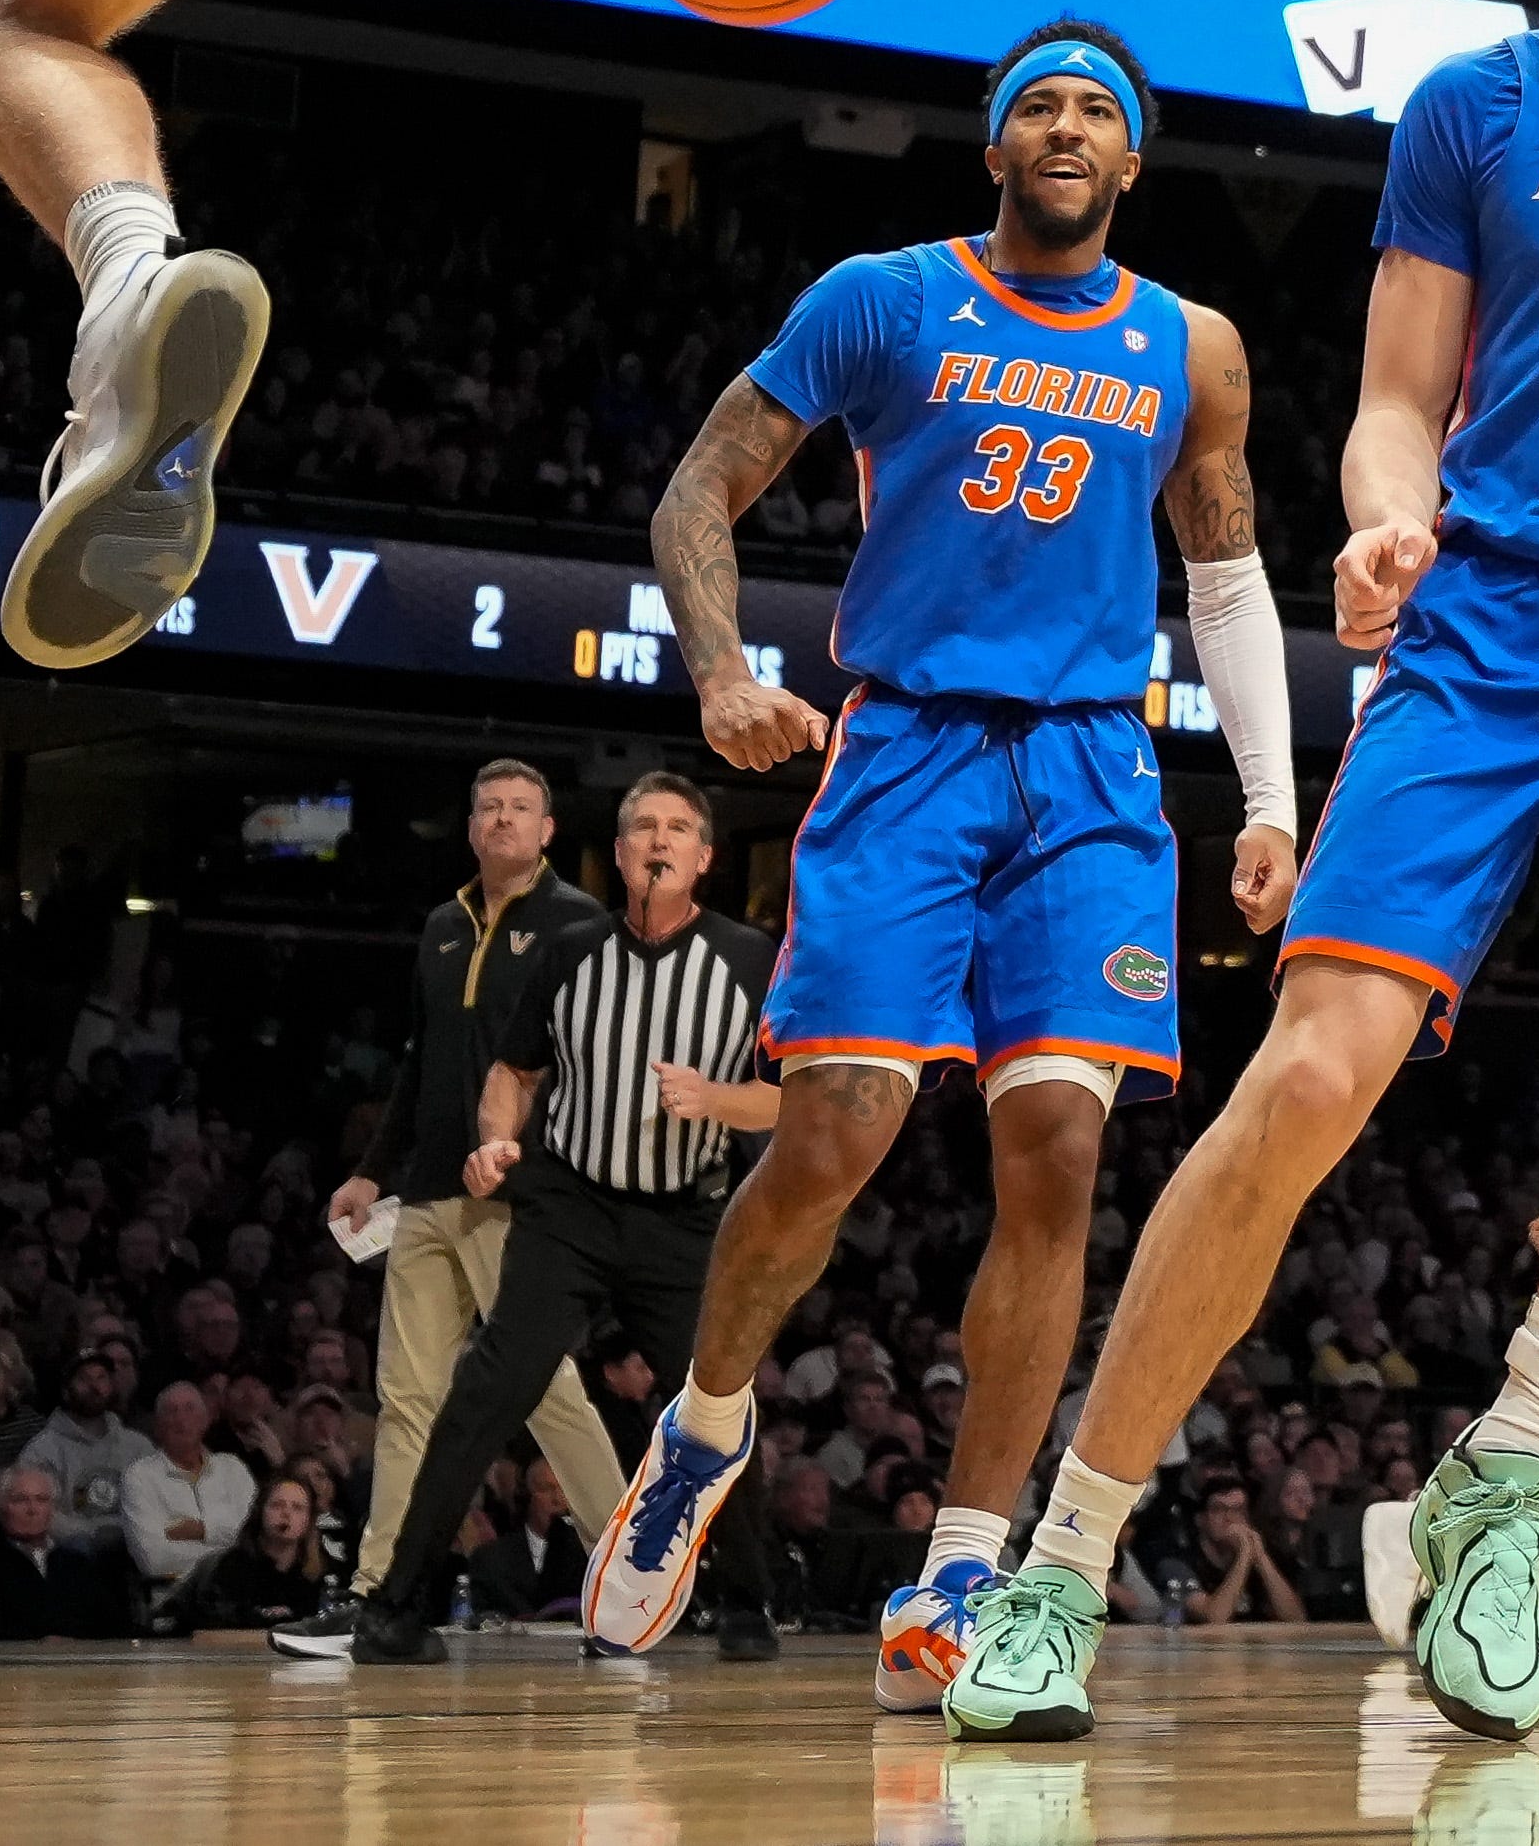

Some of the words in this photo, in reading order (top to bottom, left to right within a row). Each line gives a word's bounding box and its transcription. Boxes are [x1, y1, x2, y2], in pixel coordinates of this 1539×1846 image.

[1304, 27, 1366, 91] V
[926, 352, 1161, 437] FLORIDA
[959, 424, 1093, 524] 33
[259, 541, 380, 644] V
[472, 585, 504, 649] 2
[574, 629, 598, 678] 0
[600, 631, 661, 684] PTS
[510, 930, 536, 955] V
